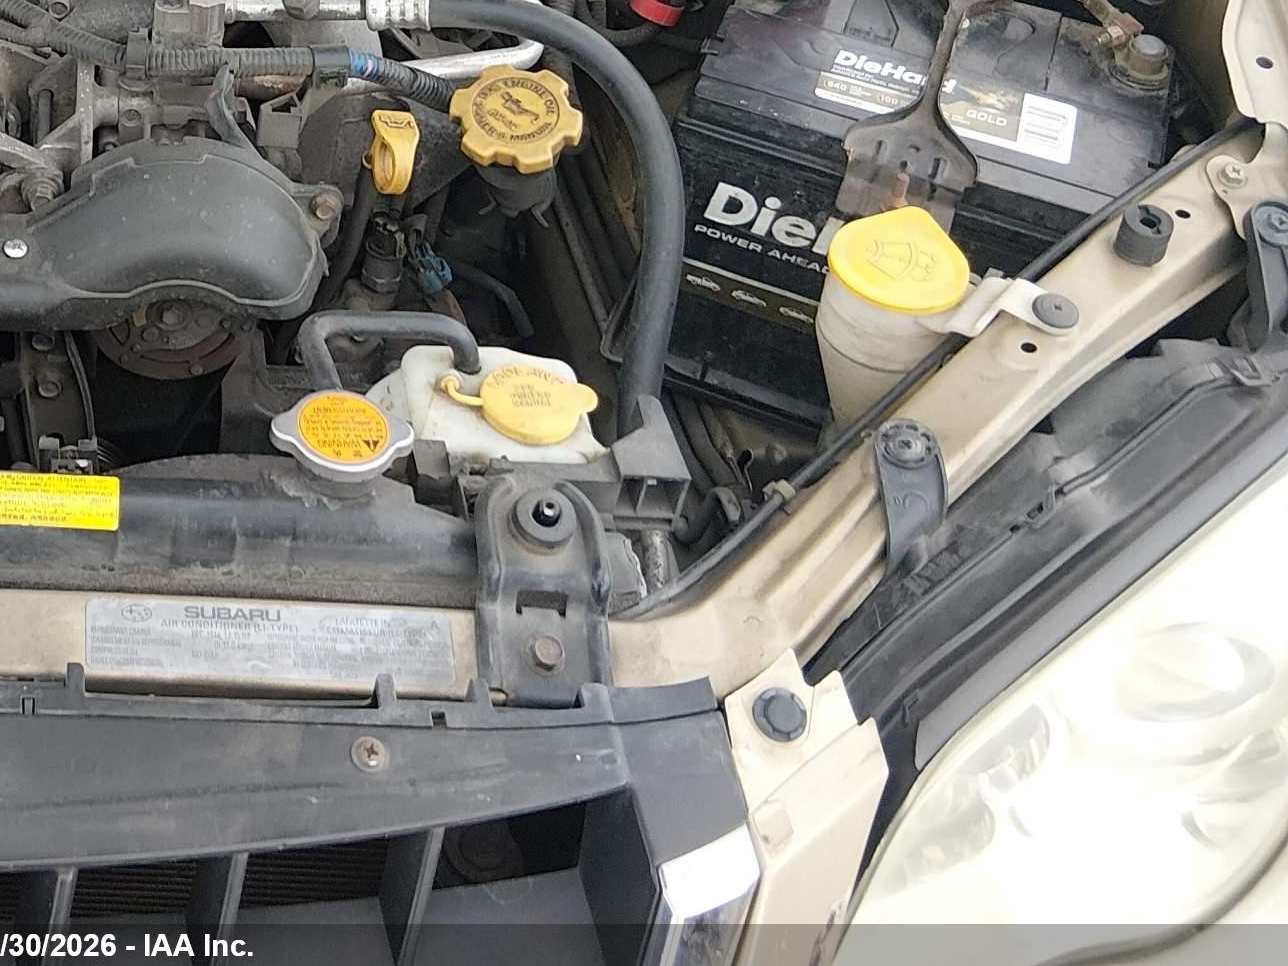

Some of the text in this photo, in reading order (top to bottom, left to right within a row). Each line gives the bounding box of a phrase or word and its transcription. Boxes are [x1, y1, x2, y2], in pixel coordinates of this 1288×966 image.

[834, 50, 956, 94] DieHad
[966, 108, 1008, 127] GOLD
[694, 224, 763, 253] POWER
[317, 438, 363, 450] WARNING
[184, 606, 281, 622] SUBARU
[181, 620, 252, 631] CONDITIONER
